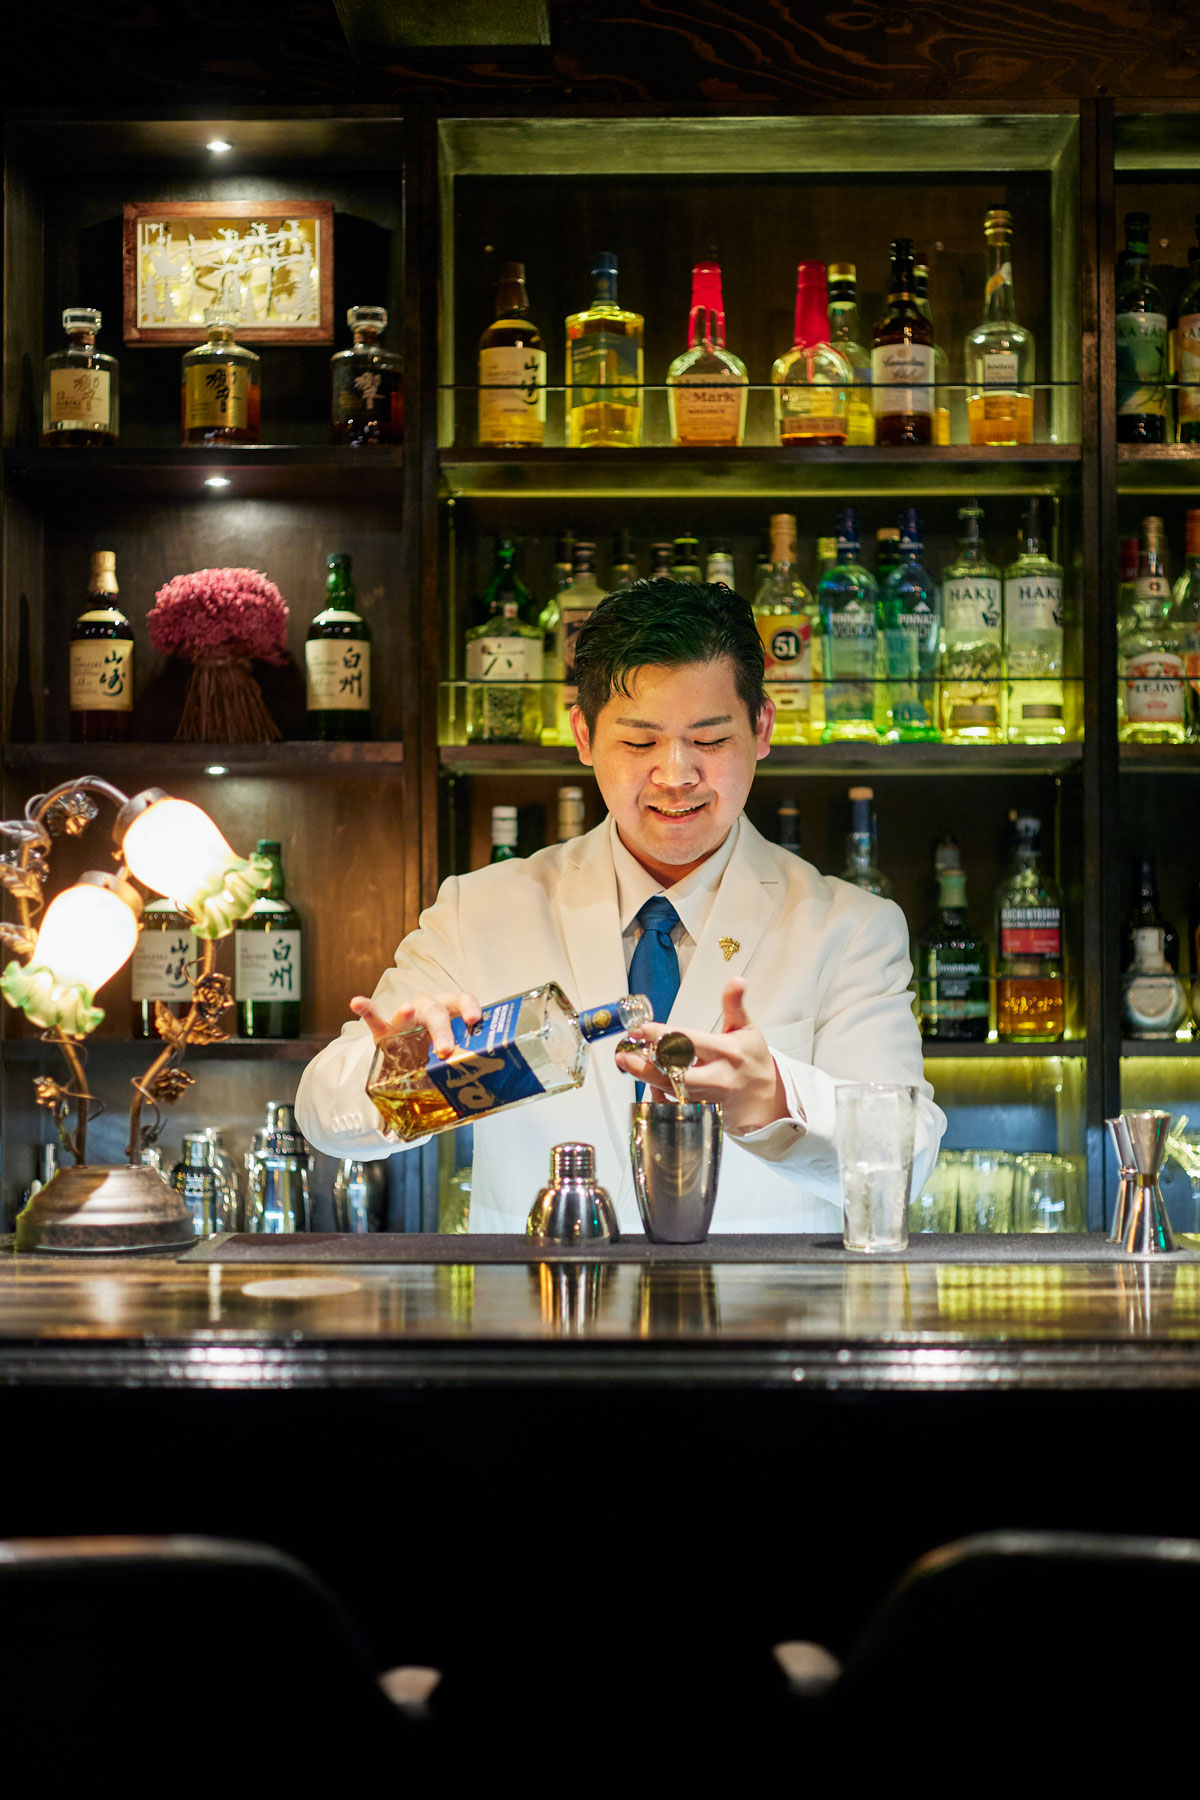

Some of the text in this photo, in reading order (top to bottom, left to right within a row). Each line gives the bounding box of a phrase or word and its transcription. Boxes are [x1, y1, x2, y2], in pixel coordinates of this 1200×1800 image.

[693, 391, 736, 403] Mark
[950, 586, 998, 601] HAKU
[773, 635, 798, 657] 51
[99, 649, 126, 697] 山崎
[339, 646, 362, 699] 白州
[165, 937, 190, 989] 山崎
[268, 938, 293, 992] 白州
